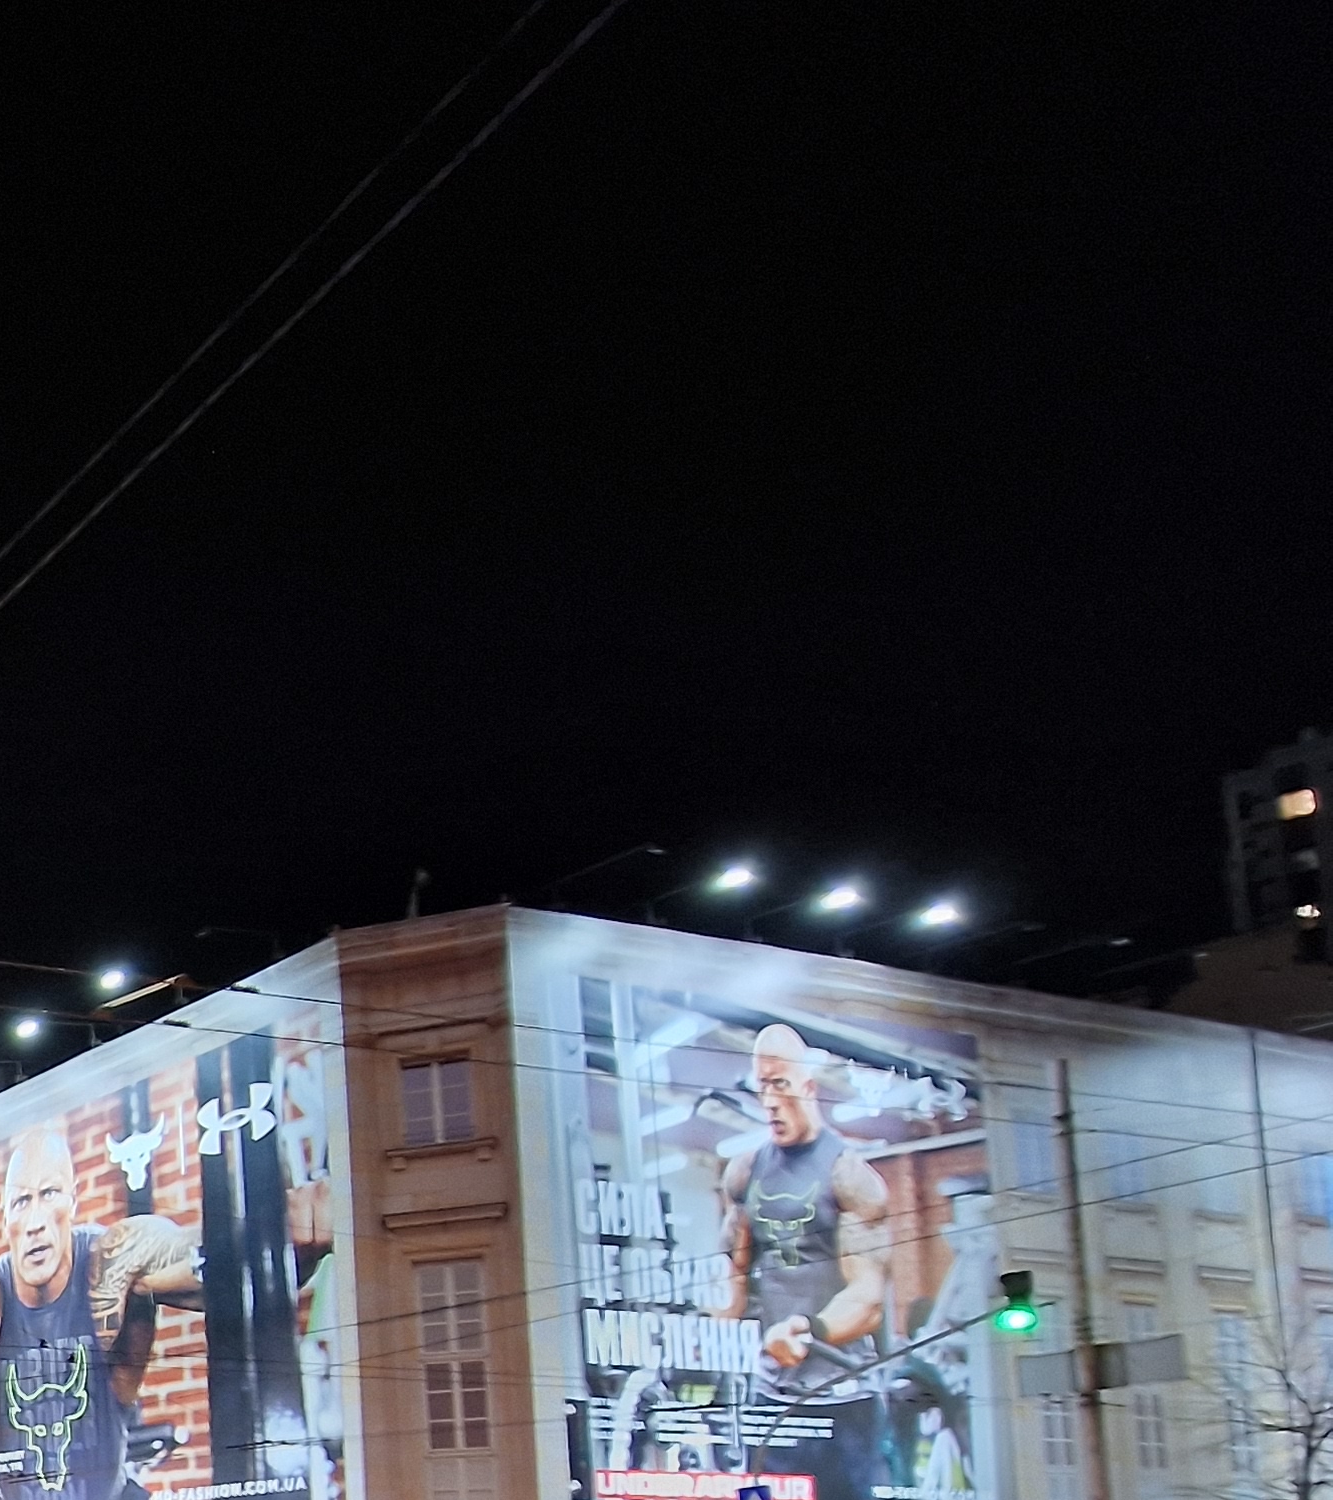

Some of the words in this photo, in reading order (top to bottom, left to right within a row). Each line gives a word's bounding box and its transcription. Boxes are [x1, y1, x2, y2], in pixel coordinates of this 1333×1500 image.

[579, 1243, 623, 1306] ЦЕ
[630, 1248, 733, 1311] ОБРАЗ
[585, 1308, 762, 1373] МИСЛЕННЯ
[597, 1472, 695, 1500] UNDER
